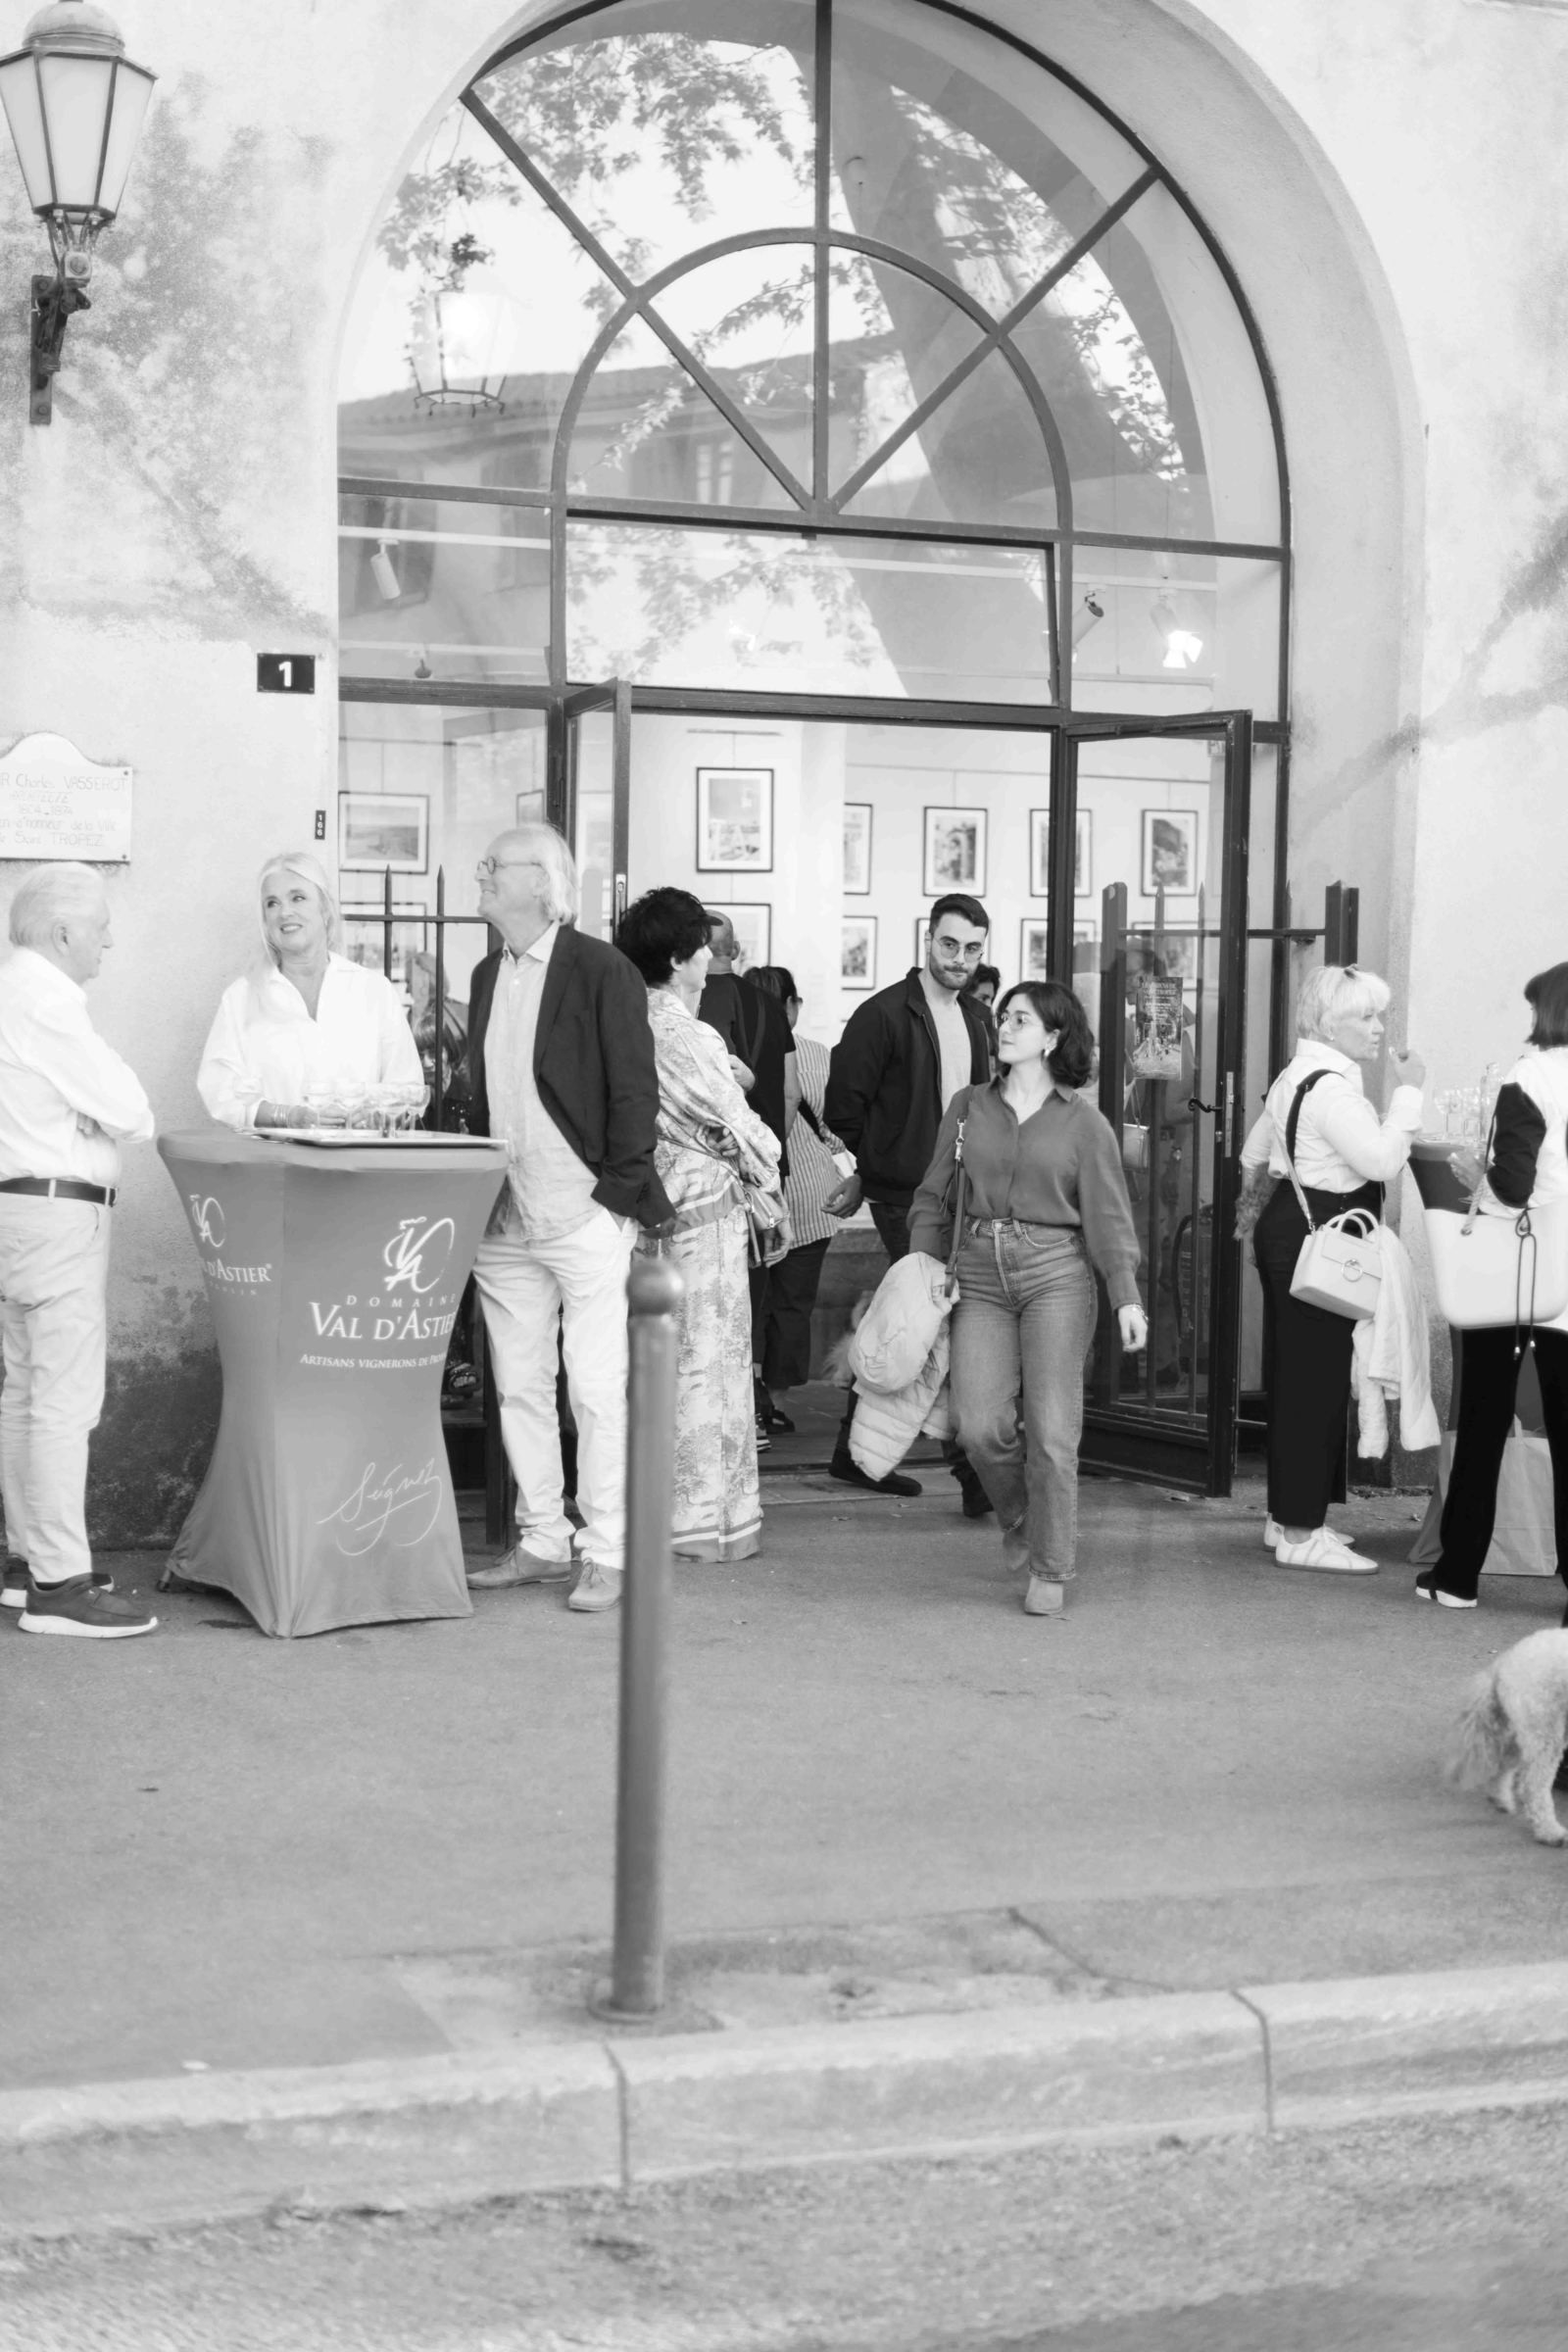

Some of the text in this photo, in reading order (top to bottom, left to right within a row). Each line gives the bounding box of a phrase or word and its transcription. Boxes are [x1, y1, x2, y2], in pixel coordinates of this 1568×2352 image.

[278, 661, 292, 688] 1
[345, 1294, 457, 1309] DOMAINE
[309, 1301, 364, 1340] VAL
[299, 1352, 356, 1368] ARTISANS
